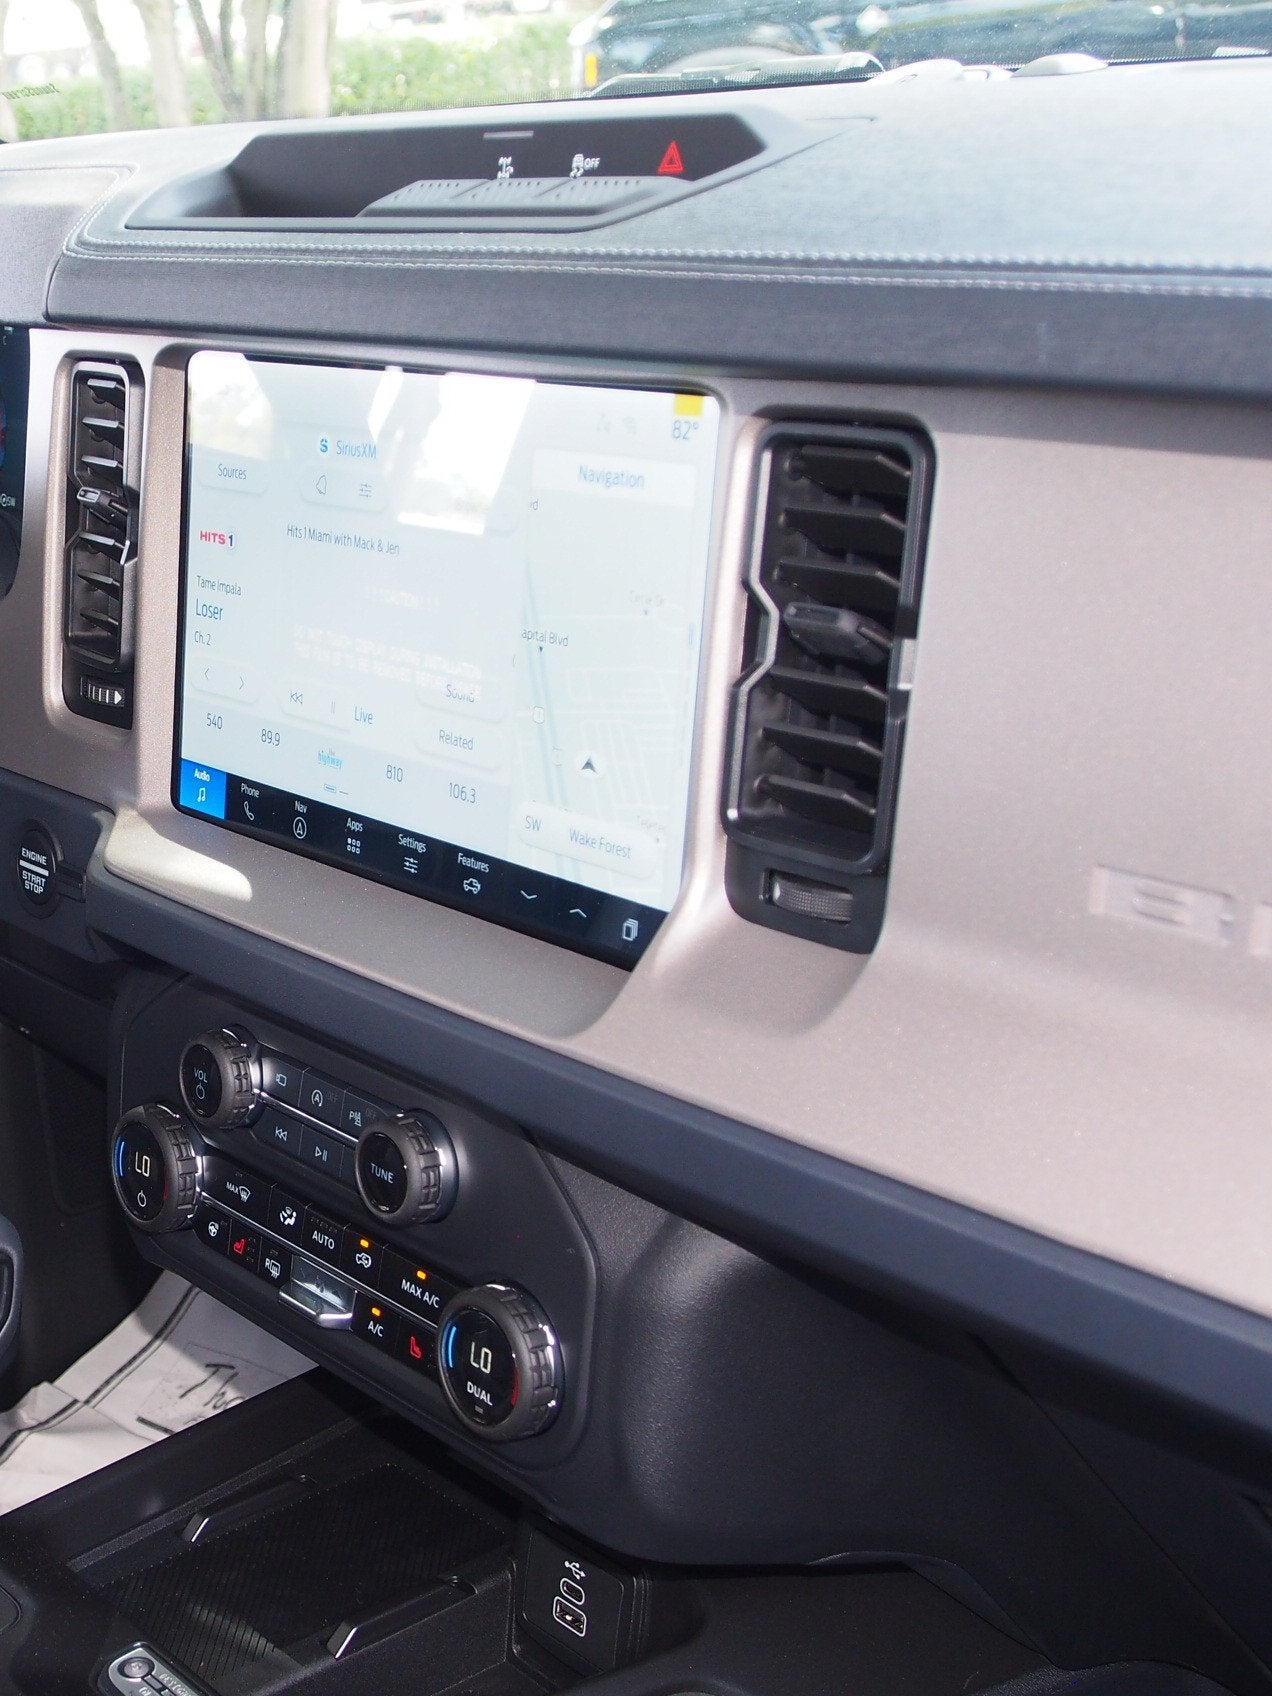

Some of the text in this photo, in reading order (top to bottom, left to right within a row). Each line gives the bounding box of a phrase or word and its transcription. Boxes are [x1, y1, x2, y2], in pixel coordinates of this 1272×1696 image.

[584, 157, 600, 170] OFF
[336, 439, 377, 459] SiriusXM
[217, 463, 247, 480] Sources
[579, 465, 645, 489] Navigation
[199, 530, 226, 545] HITS
[287, 524, 302, 539] Hits
[309, 527, 332, 544] Miami
[334, 531, 352, 547] with
[354, 535, 375, 551] Mack
[385, 542, 400, 555] Jen
[196, 575, 242, 596] Tame Impala
[195, 599, 223, 620] Loser
[521, 628, 569, 647] apital Blvd
[206, 712, 223, 730] 540
[354, 706, 374, 725] Live
[261, 728, 281, 746] 89.9
[439, 729, 474, 750] Related
[193, 767, 210, 782] Audio
[386, 764, 403, 783] 810
[241, 783, 260, 799] Phone
[448, 782, 477, 804] 106.3
[294, 800, 308, 814] Nav
[346, 817, 363, 832] Apps
[524, 815, 543, 832] SW
[398, 834, 426, 853] Settings
[569, 828, 632, 859] Wake Forest
[21, 847, 47, 865] ENGINE
[457, 852, 490, 874] Features
[22, 870, 46, 887] START
[24, 880, 43, 894] STOP
[193, 1066, 208, 1084] VOL
[135, 1150, 151, 1178] LO
[370, 1162, 394, 1184] TUNE
[226, 1181, 240, 1194] MAX
[311, 1230, 335, 1250] AUTO
[401, 1278, 440, 1309] MAX A/C
[367, 1320, 384, 1338] A/C
[470, 1341, 492, 1374] LO
[466, 1381, 493, 1406] DUAL
